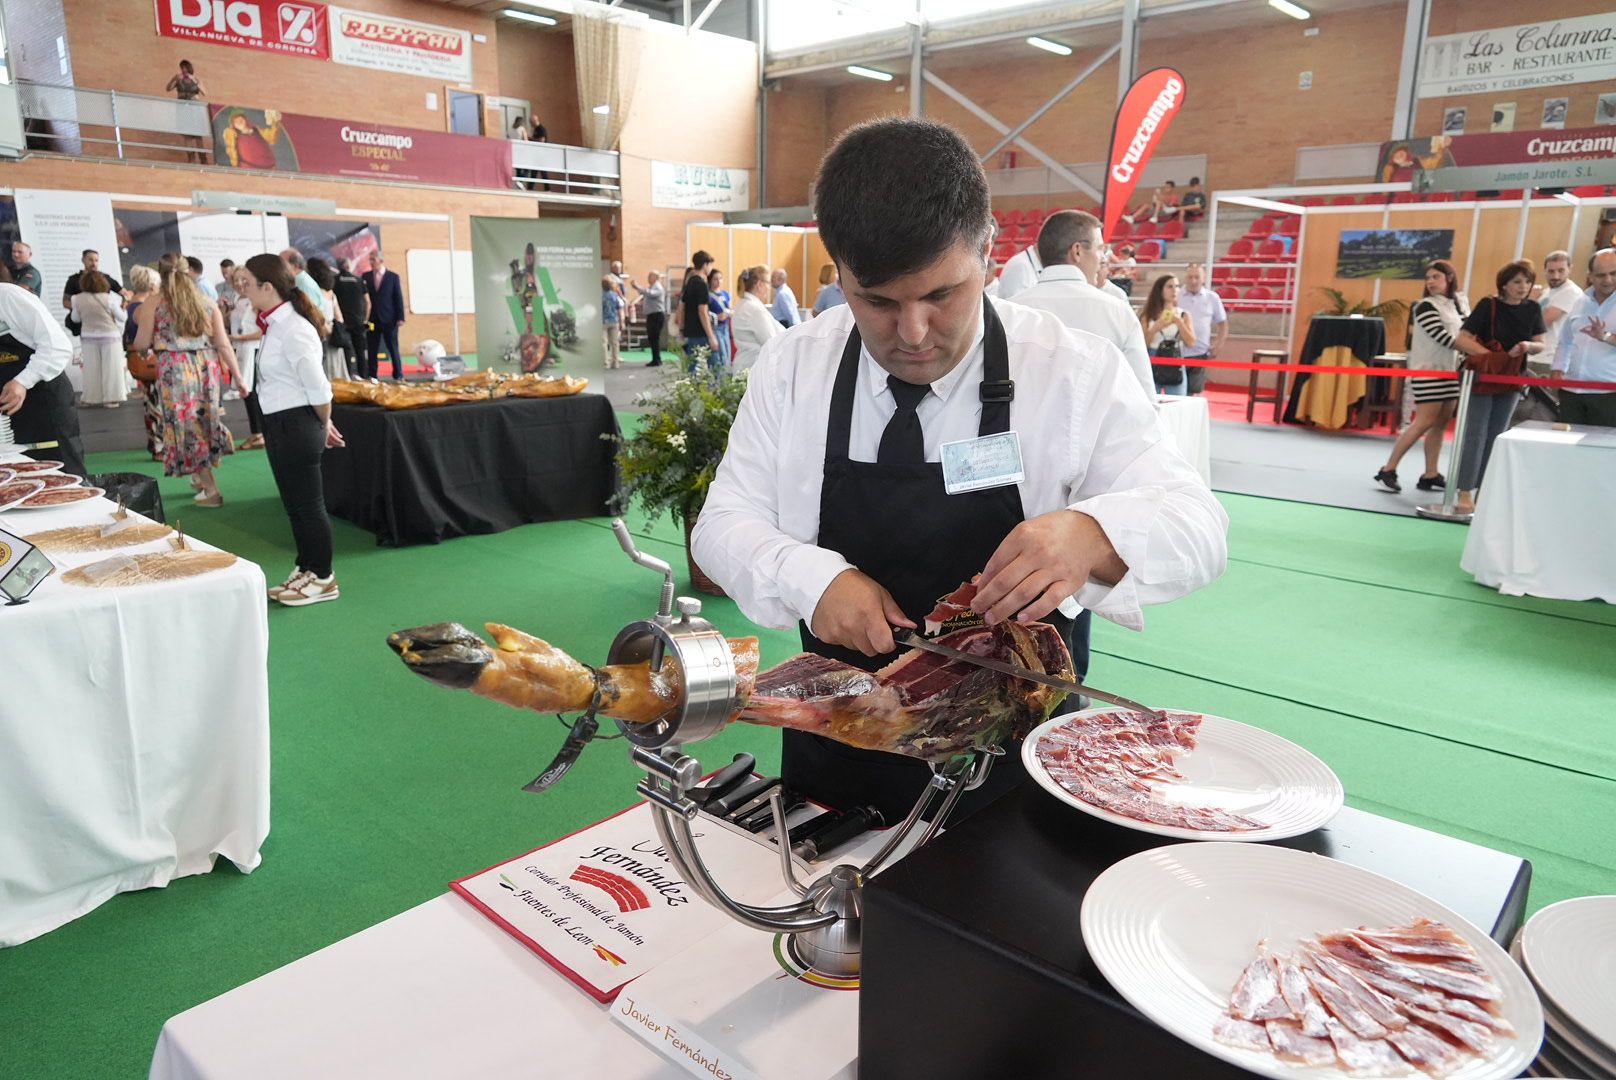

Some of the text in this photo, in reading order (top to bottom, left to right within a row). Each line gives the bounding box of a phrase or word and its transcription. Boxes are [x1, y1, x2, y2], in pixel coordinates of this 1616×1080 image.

[172, 27, 318, 55] VILLANUEVA DE CORDOBA
[346, 20, 460, 50] ROSYPAN
[1463, 31, 1504, 59] Las
[1466, 60, 1492, 76] BAR
[1512, 46, 1612, 70] RESTAURANTE
[1447, 73, 1575, 94] BAUTIZOS Y CELEBRACIONES
[341, 126, 413, 150] Cruzcampo
[1112, 76, 1182, 183] Cruzcampo
[352, 146, 406, 160] ESPECIAL
[580, 846, 689, 907] Fernández
[513, 890, 557, 918] Fuentes
[551, 916, 569, 929] de
[524, 865, 645, 946] Cortador Profesional de Jamón
[621, 996, 733, 1080] Javier Fernández
